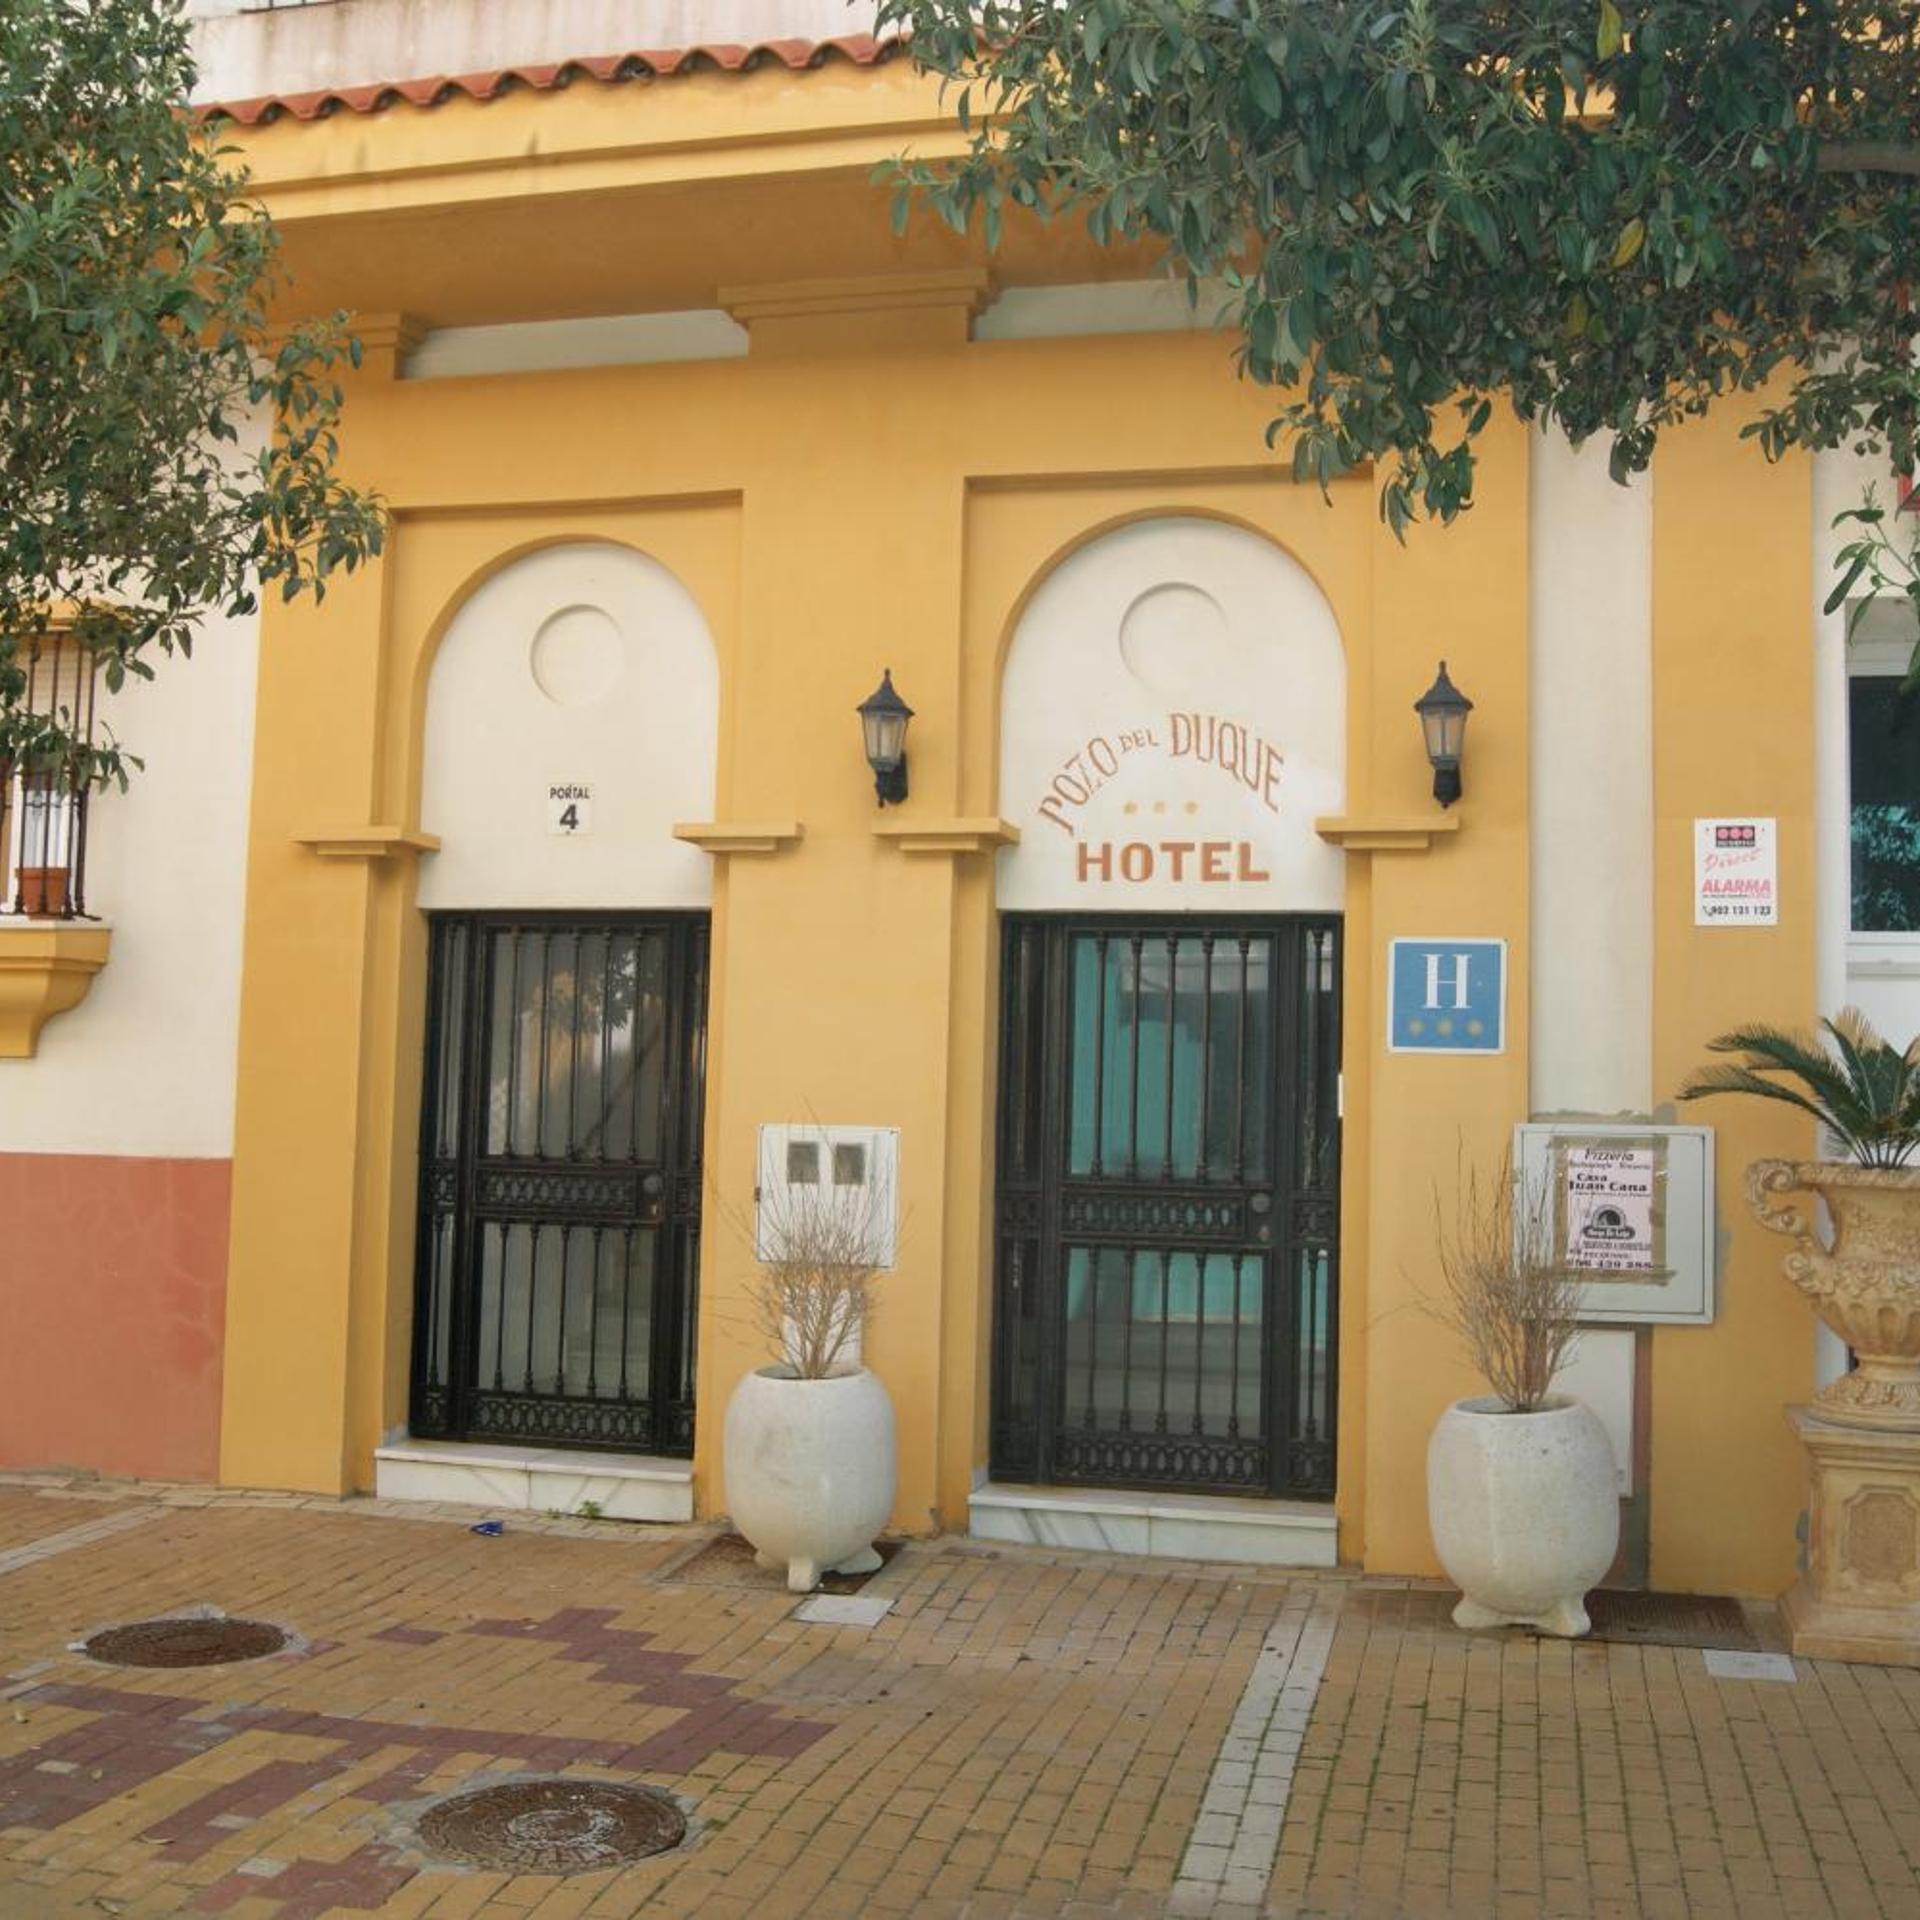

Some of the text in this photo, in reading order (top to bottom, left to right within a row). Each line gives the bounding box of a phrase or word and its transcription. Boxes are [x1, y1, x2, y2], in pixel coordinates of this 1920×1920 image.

[1038, 711, 1284, 836] POZO DEL DUQUE
[549, 786, 590, 800] PORTAL
[559, 804, 579, 830] 4
[1076, 841, 1271, 883] HOTEL
[1702, 878, 1771, 894] ALARMA
[1420, 953, 1472, 1009] H
